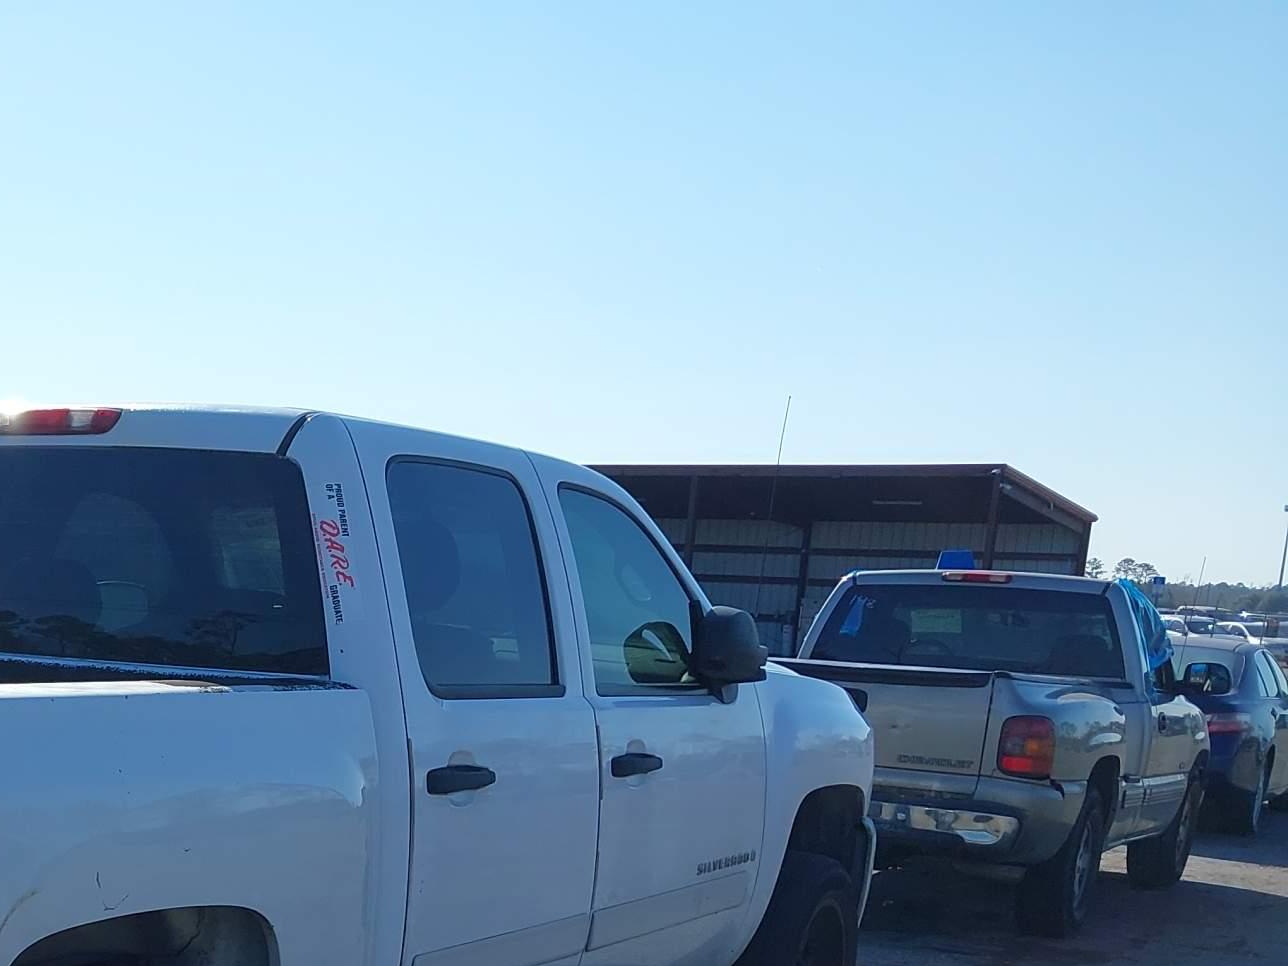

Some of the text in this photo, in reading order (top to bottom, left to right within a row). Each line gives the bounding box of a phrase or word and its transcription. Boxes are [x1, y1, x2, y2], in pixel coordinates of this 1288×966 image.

[325, 483, 335, 493] OF
[334, 483, 350, 537] PROUD PARENT
[329, 584, 344, 625] GRADUATE
